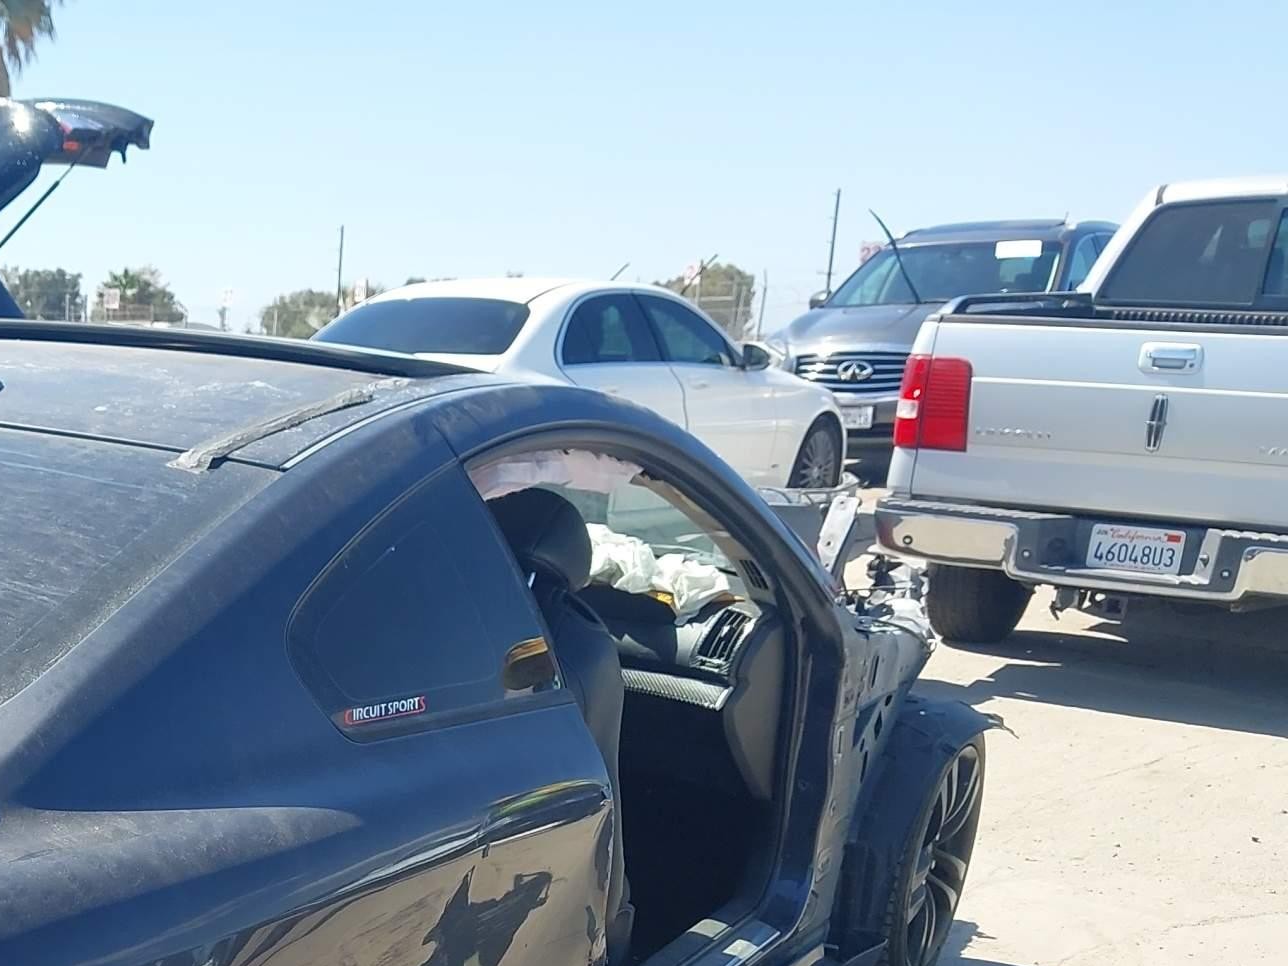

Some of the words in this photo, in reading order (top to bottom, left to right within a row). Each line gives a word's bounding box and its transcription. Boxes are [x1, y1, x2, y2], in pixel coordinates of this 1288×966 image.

[1094, 542, 1176, 568] 46048U3
[344, 703, 387, 725] CIRCUIT
[388, 696, 426, 715] SPORTS
